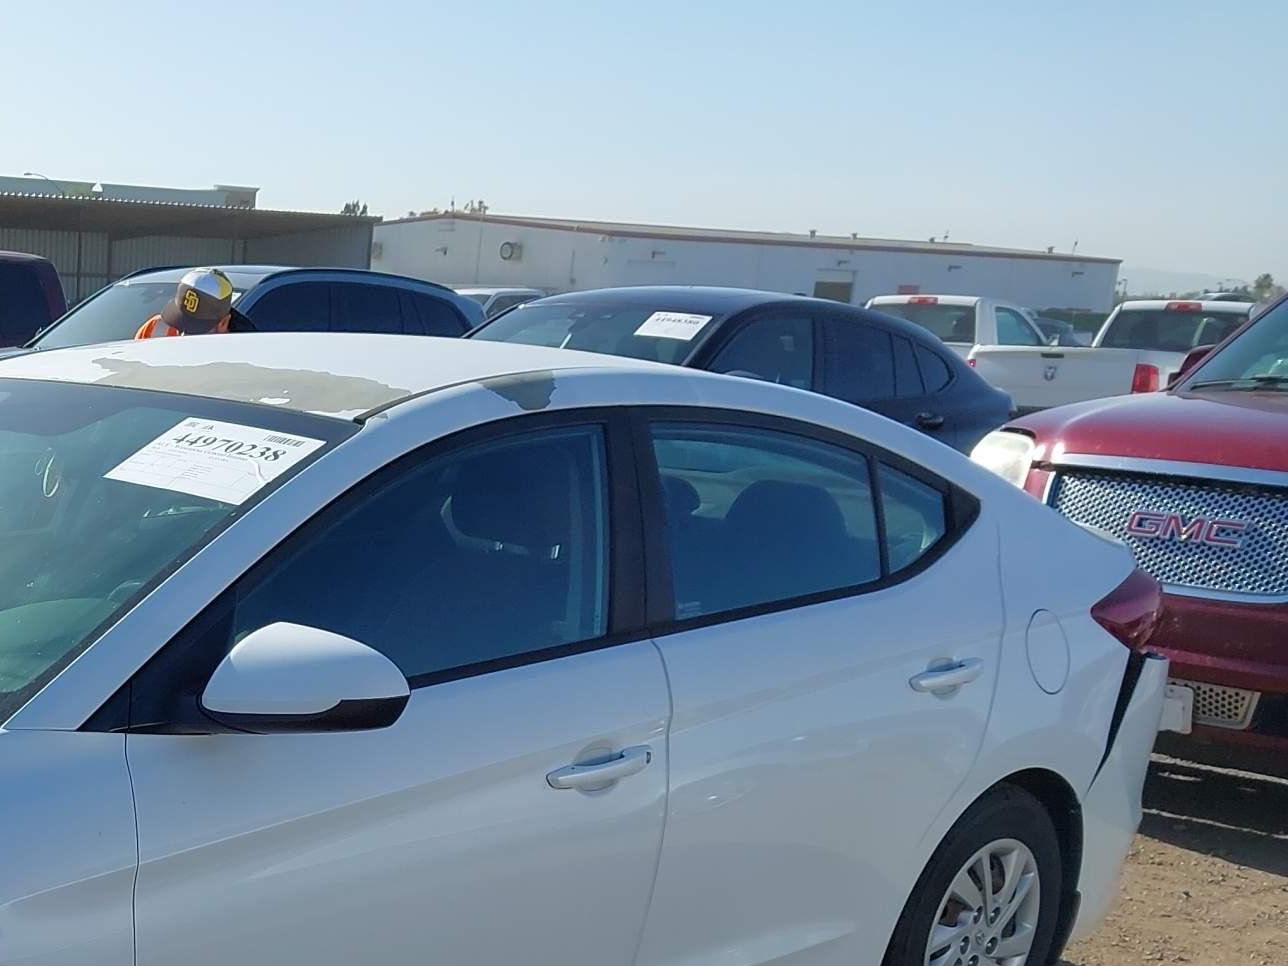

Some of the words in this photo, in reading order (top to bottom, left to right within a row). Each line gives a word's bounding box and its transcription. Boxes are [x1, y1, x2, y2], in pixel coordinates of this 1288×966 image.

[184, 290, 200, 313] SD
[173, 431, 287, 462] 44970238
[1127, 511, 1246, 549] GMC
